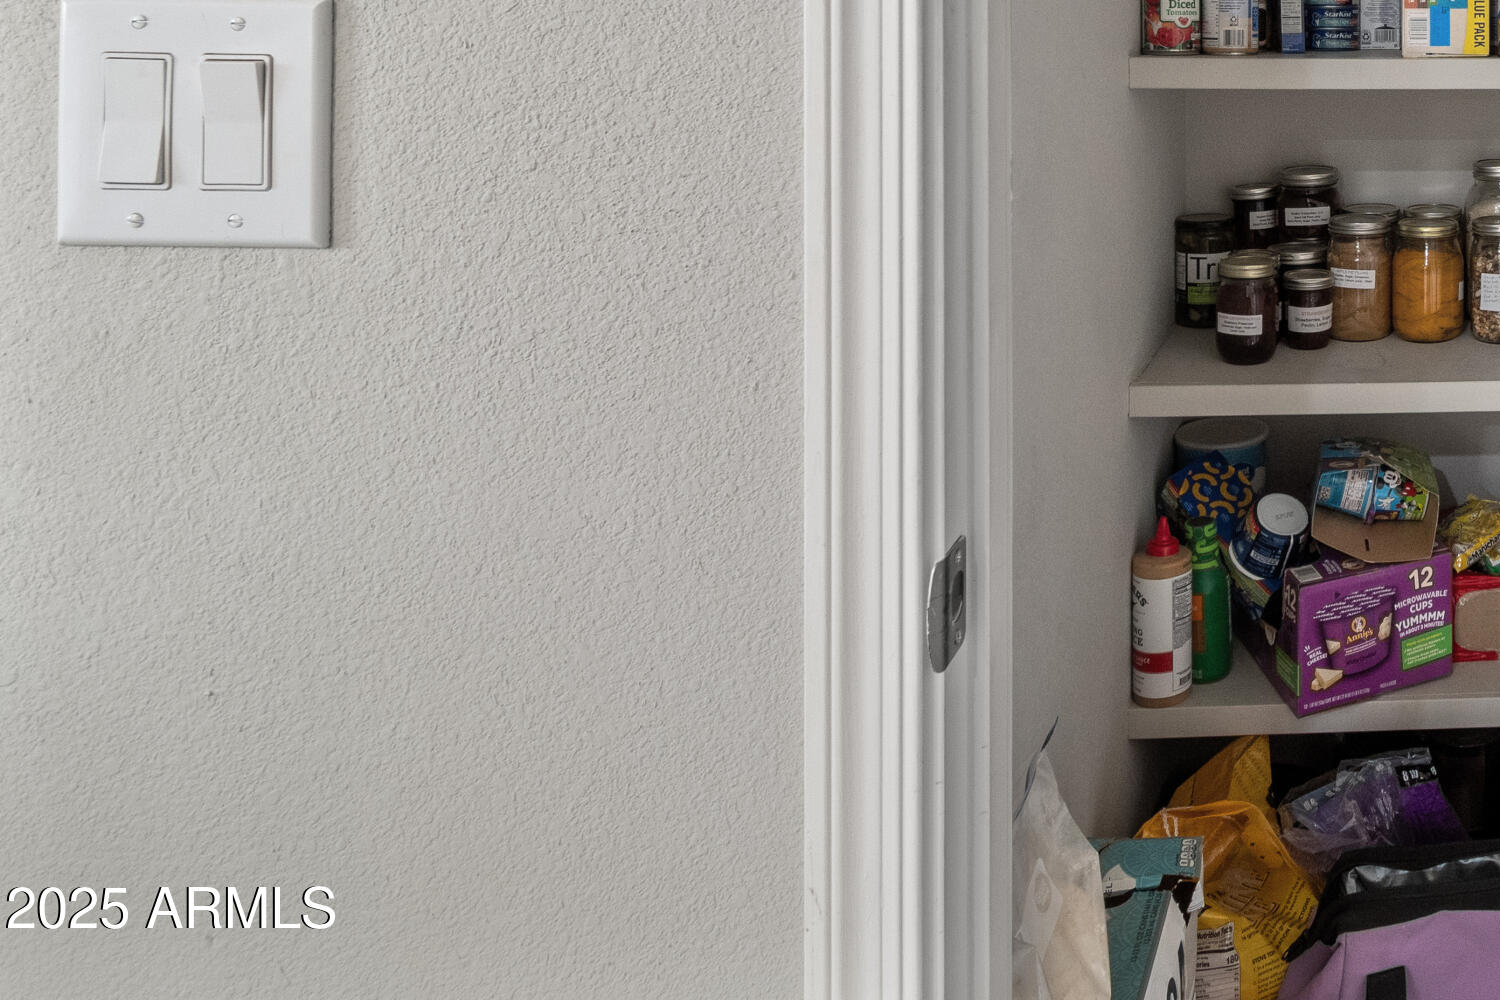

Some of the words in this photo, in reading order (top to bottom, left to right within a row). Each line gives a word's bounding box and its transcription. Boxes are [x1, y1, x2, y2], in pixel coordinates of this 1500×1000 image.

[1168, 0, 1196, 9] Diced
[1474, 20, 1485, 48] PACK
[1472, 534, 1500, 558] Maruchan
[1409, 566, 1433, 590] 12
[1394, 589, 1448, 611] MICROWAVABLE
[1410, 600, 1433, 614] CUPS
[1346, 627, 1374, 644] Annie's
[1405, 626, 1420, 636] ABOUT
[1424, 620, 1444, 631] MINUTES!
[1307, 653, 1328, 667] CHEESE!
[1309, 651, 1322, 659] REAL
